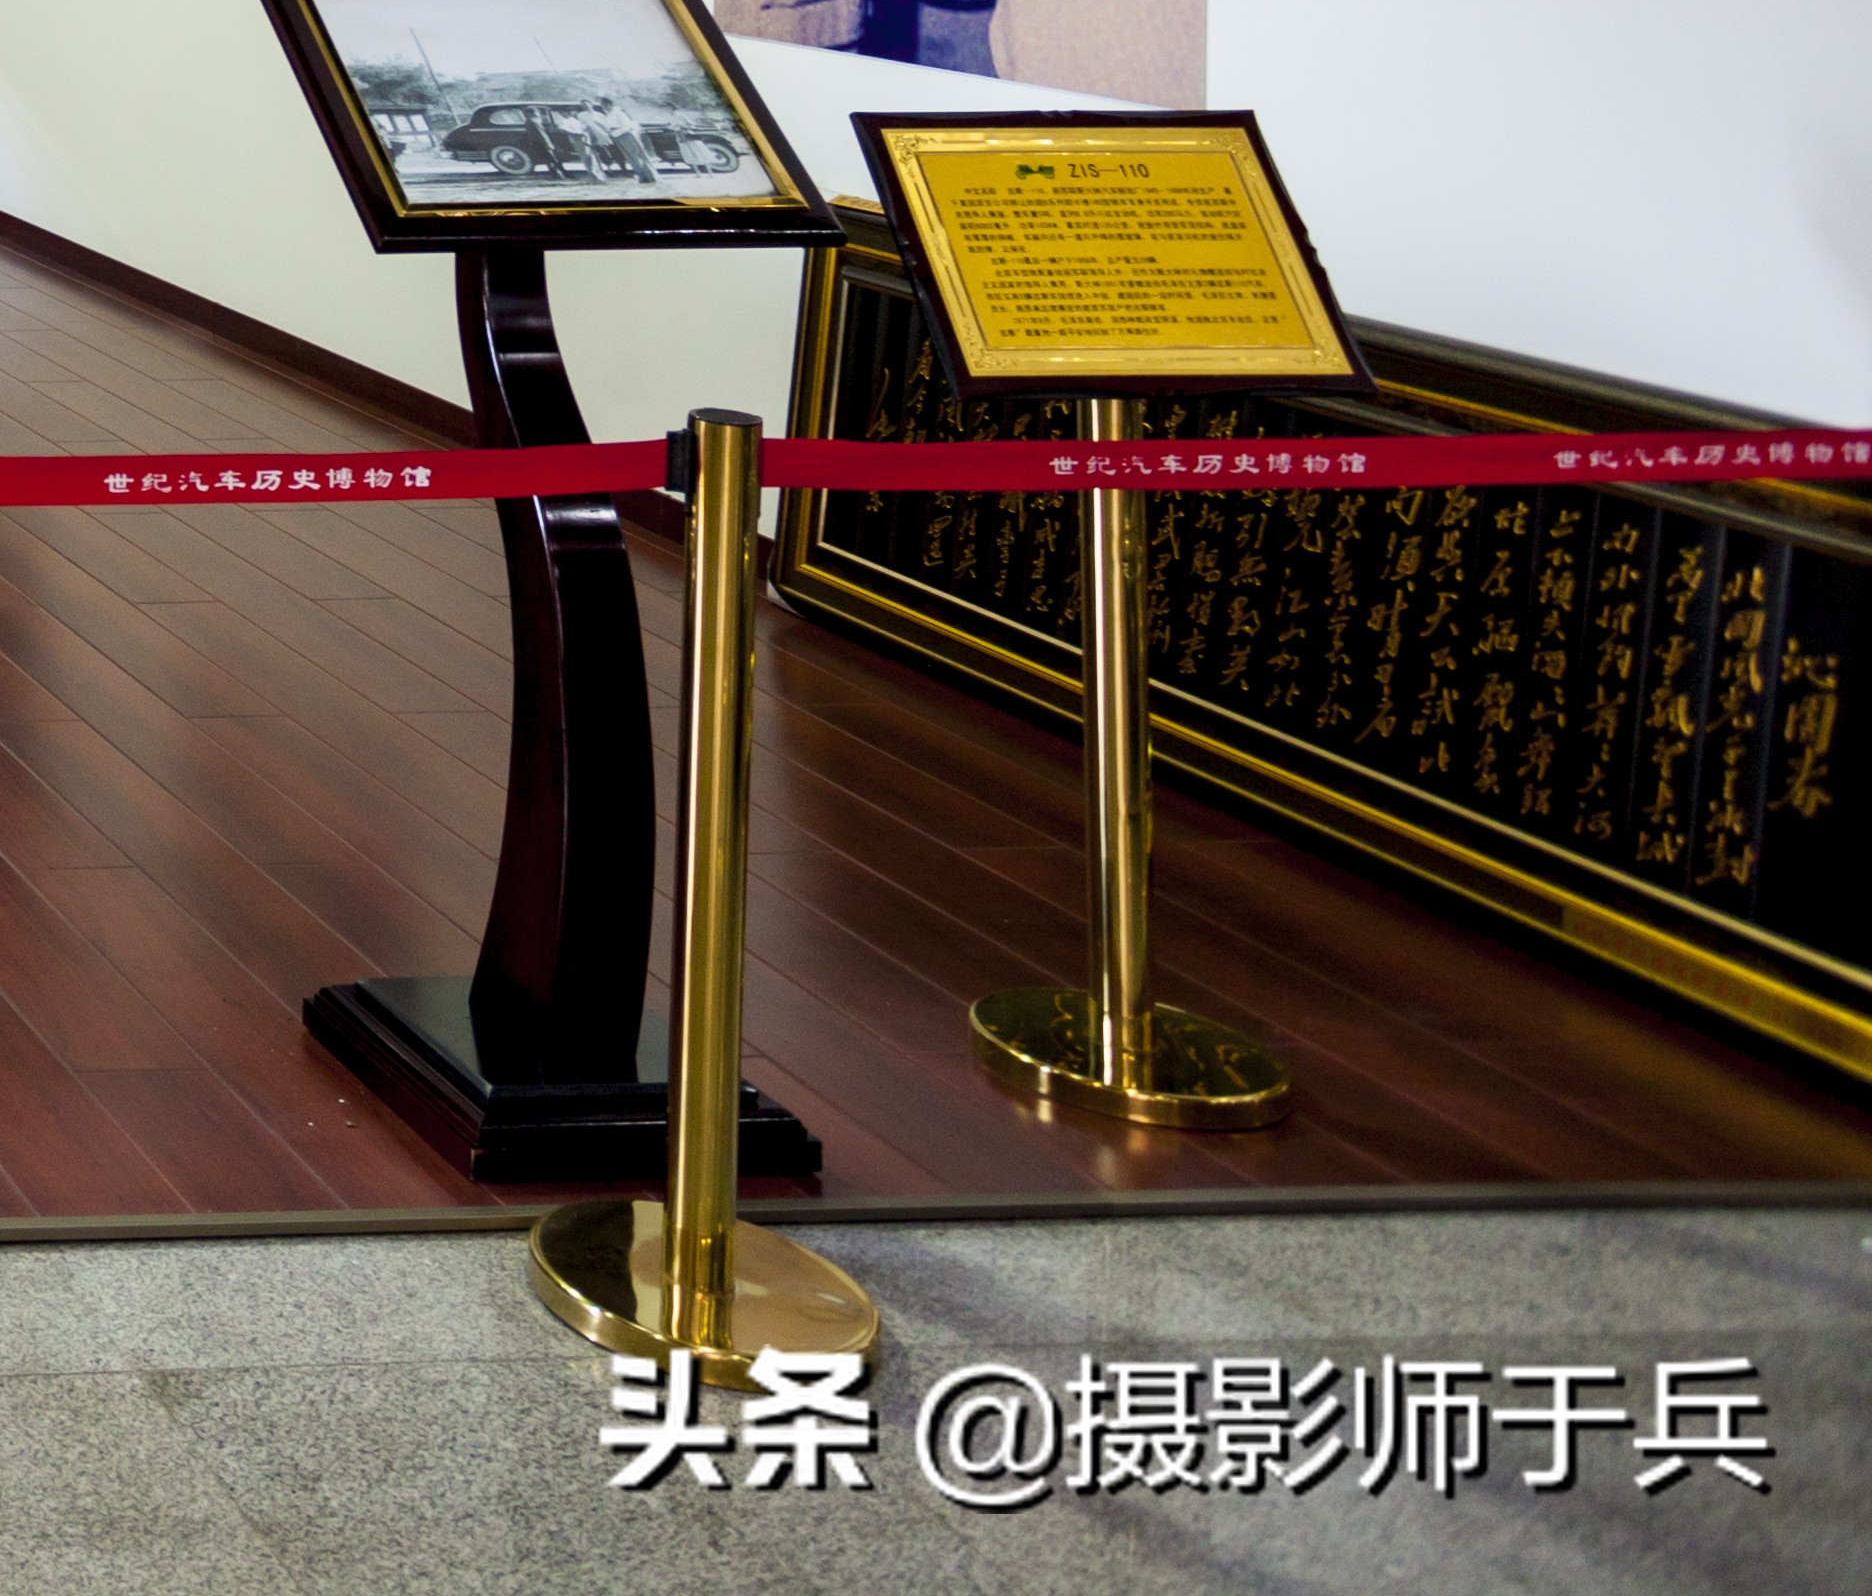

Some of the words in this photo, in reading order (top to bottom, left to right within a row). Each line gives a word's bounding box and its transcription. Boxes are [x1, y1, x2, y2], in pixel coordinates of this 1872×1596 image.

[1048, 451, 1367, 477] 世纪汽车历史博物馆
[1554, 441, 1870, 470] 世纪汽车历史博物馆
[104, 466, 432, 494] 世纪汽车历史博物馆
